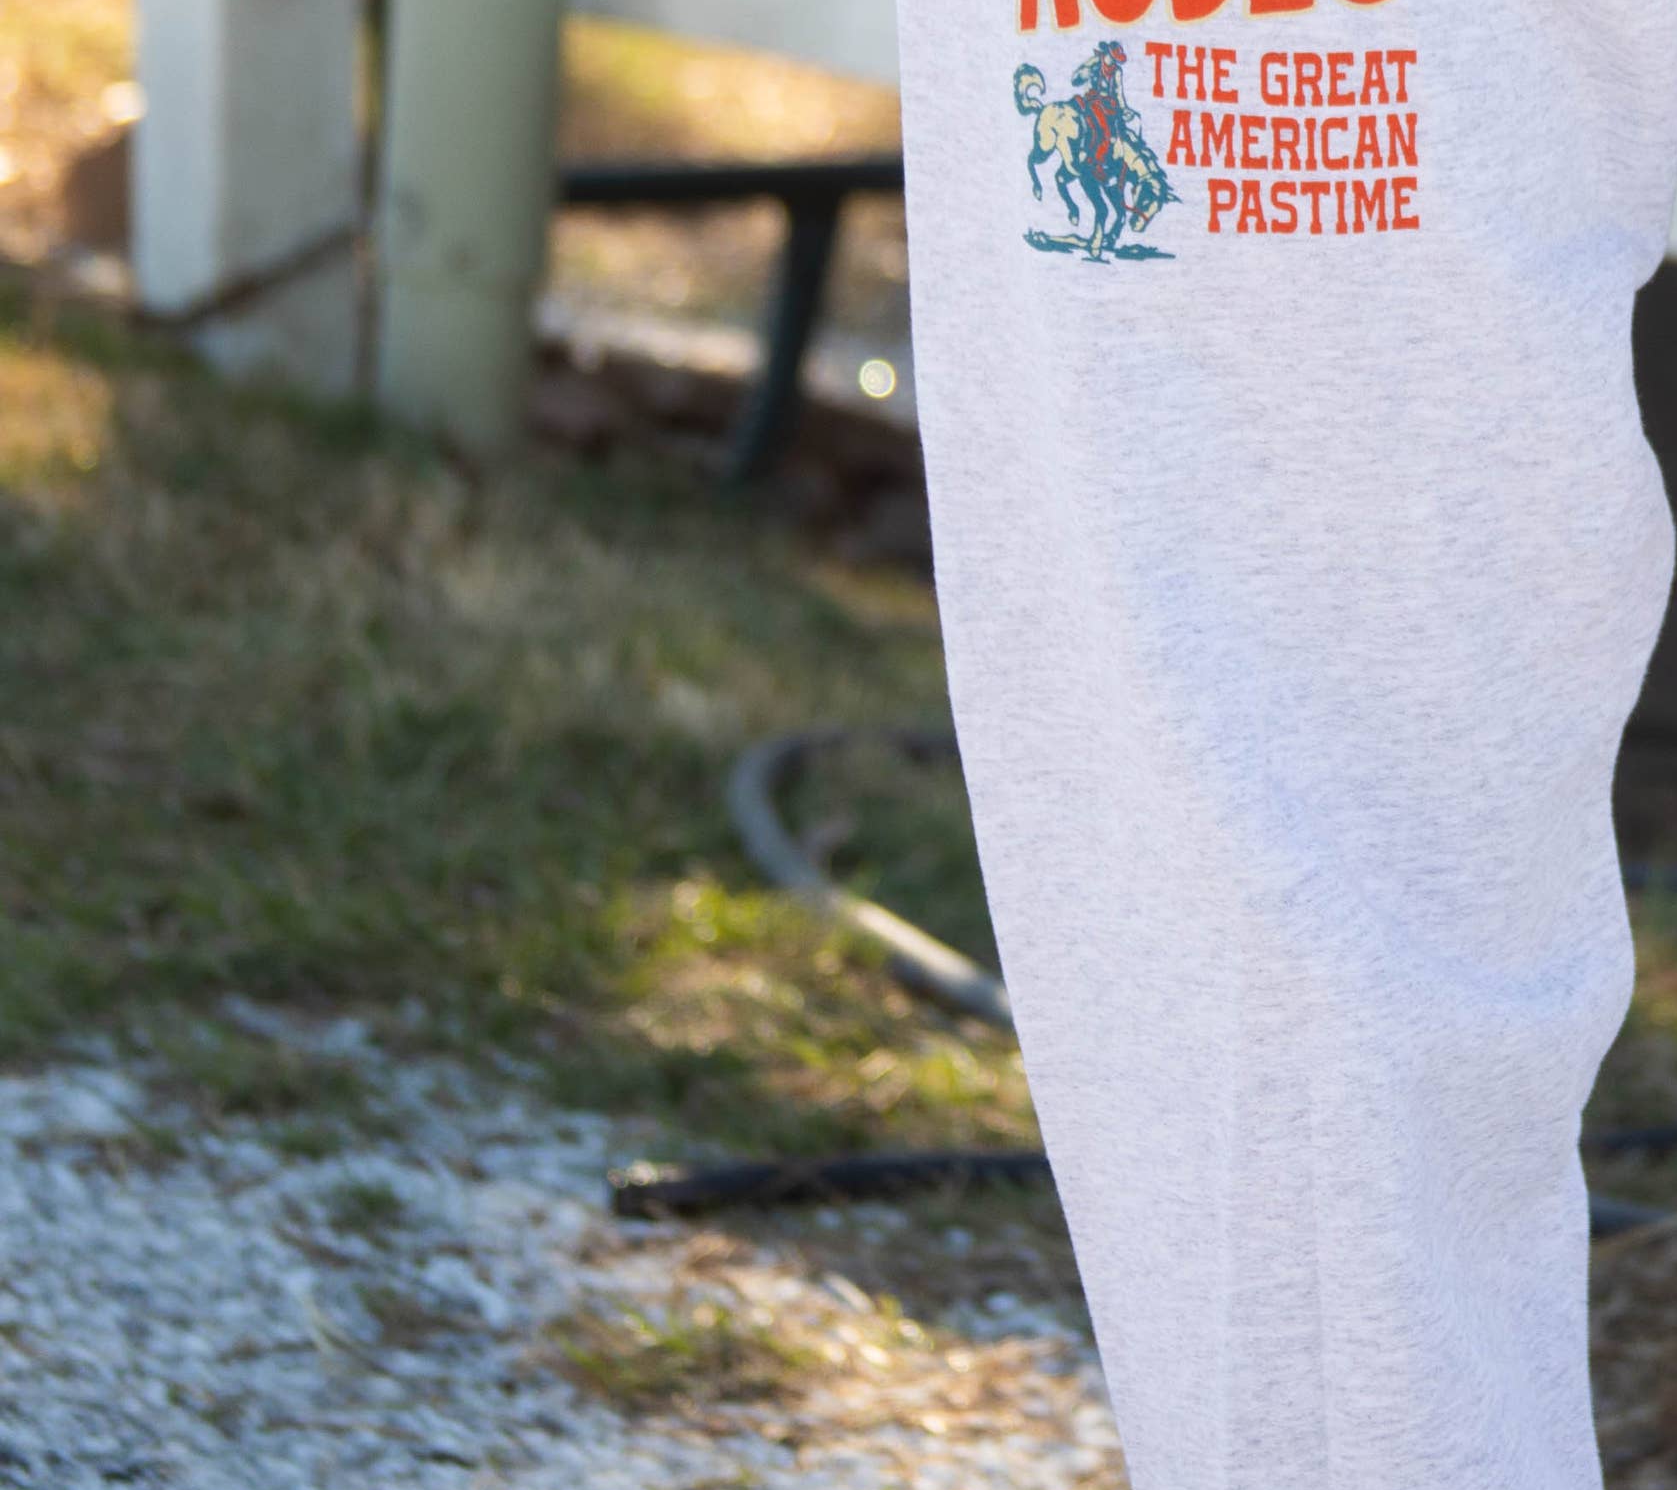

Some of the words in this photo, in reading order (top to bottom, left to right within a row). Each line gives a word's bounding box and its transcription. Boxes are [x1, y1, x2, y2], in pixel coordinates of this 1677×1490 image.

[1145, 42, 1238, 103] THE
[1260, 50, 1417, 107] GREAT
[1167, 110, 1418, 171] AMERICAN
[1207, 176, 1420, 234] PASTIME
